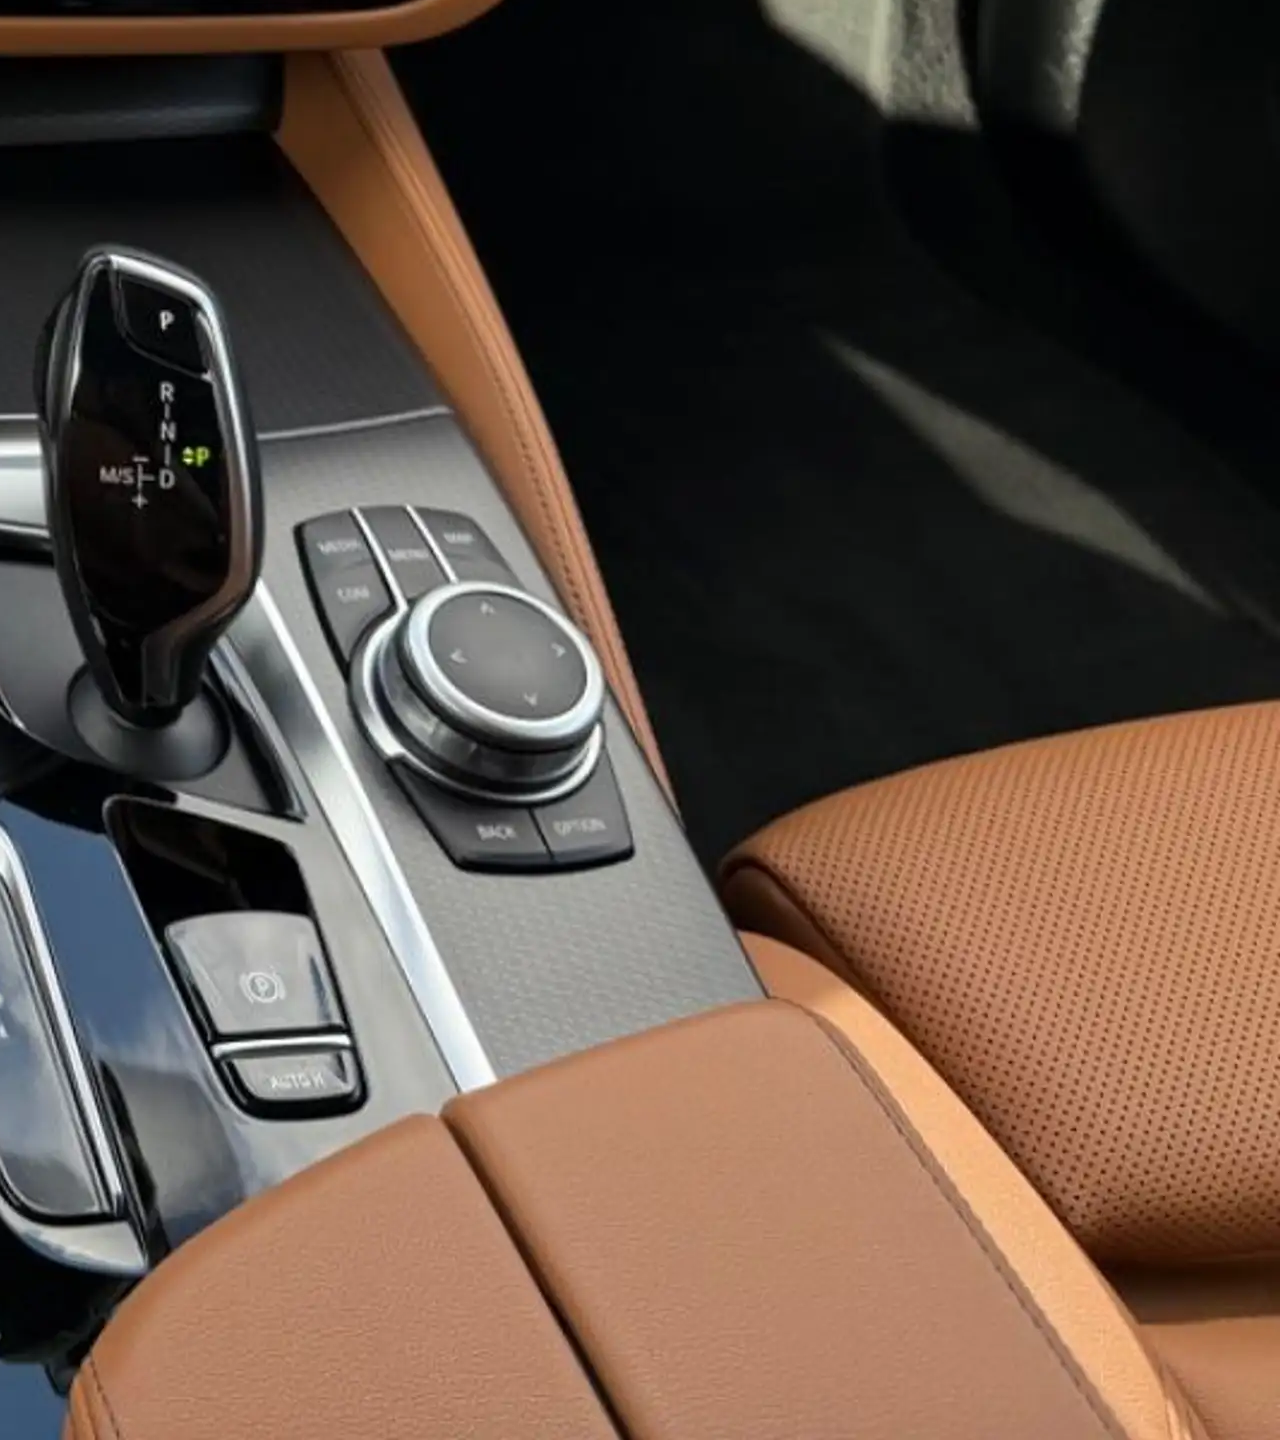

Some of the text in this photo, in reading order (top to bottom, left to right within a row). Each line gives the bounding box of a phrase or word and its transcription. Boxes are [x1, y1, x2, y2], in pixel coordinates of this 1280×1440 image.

[159, 310, 174, 331] P
[160, 381, 174, 402] R
[161, 421, 176, 442] N
[195, 446, 211, 467] P
[99, 465, 135, 485] M/S
[158, 468, 175, 489] D
[476, 821, 517, 841] BACK
[552, 817, 607, 837] OPTION
